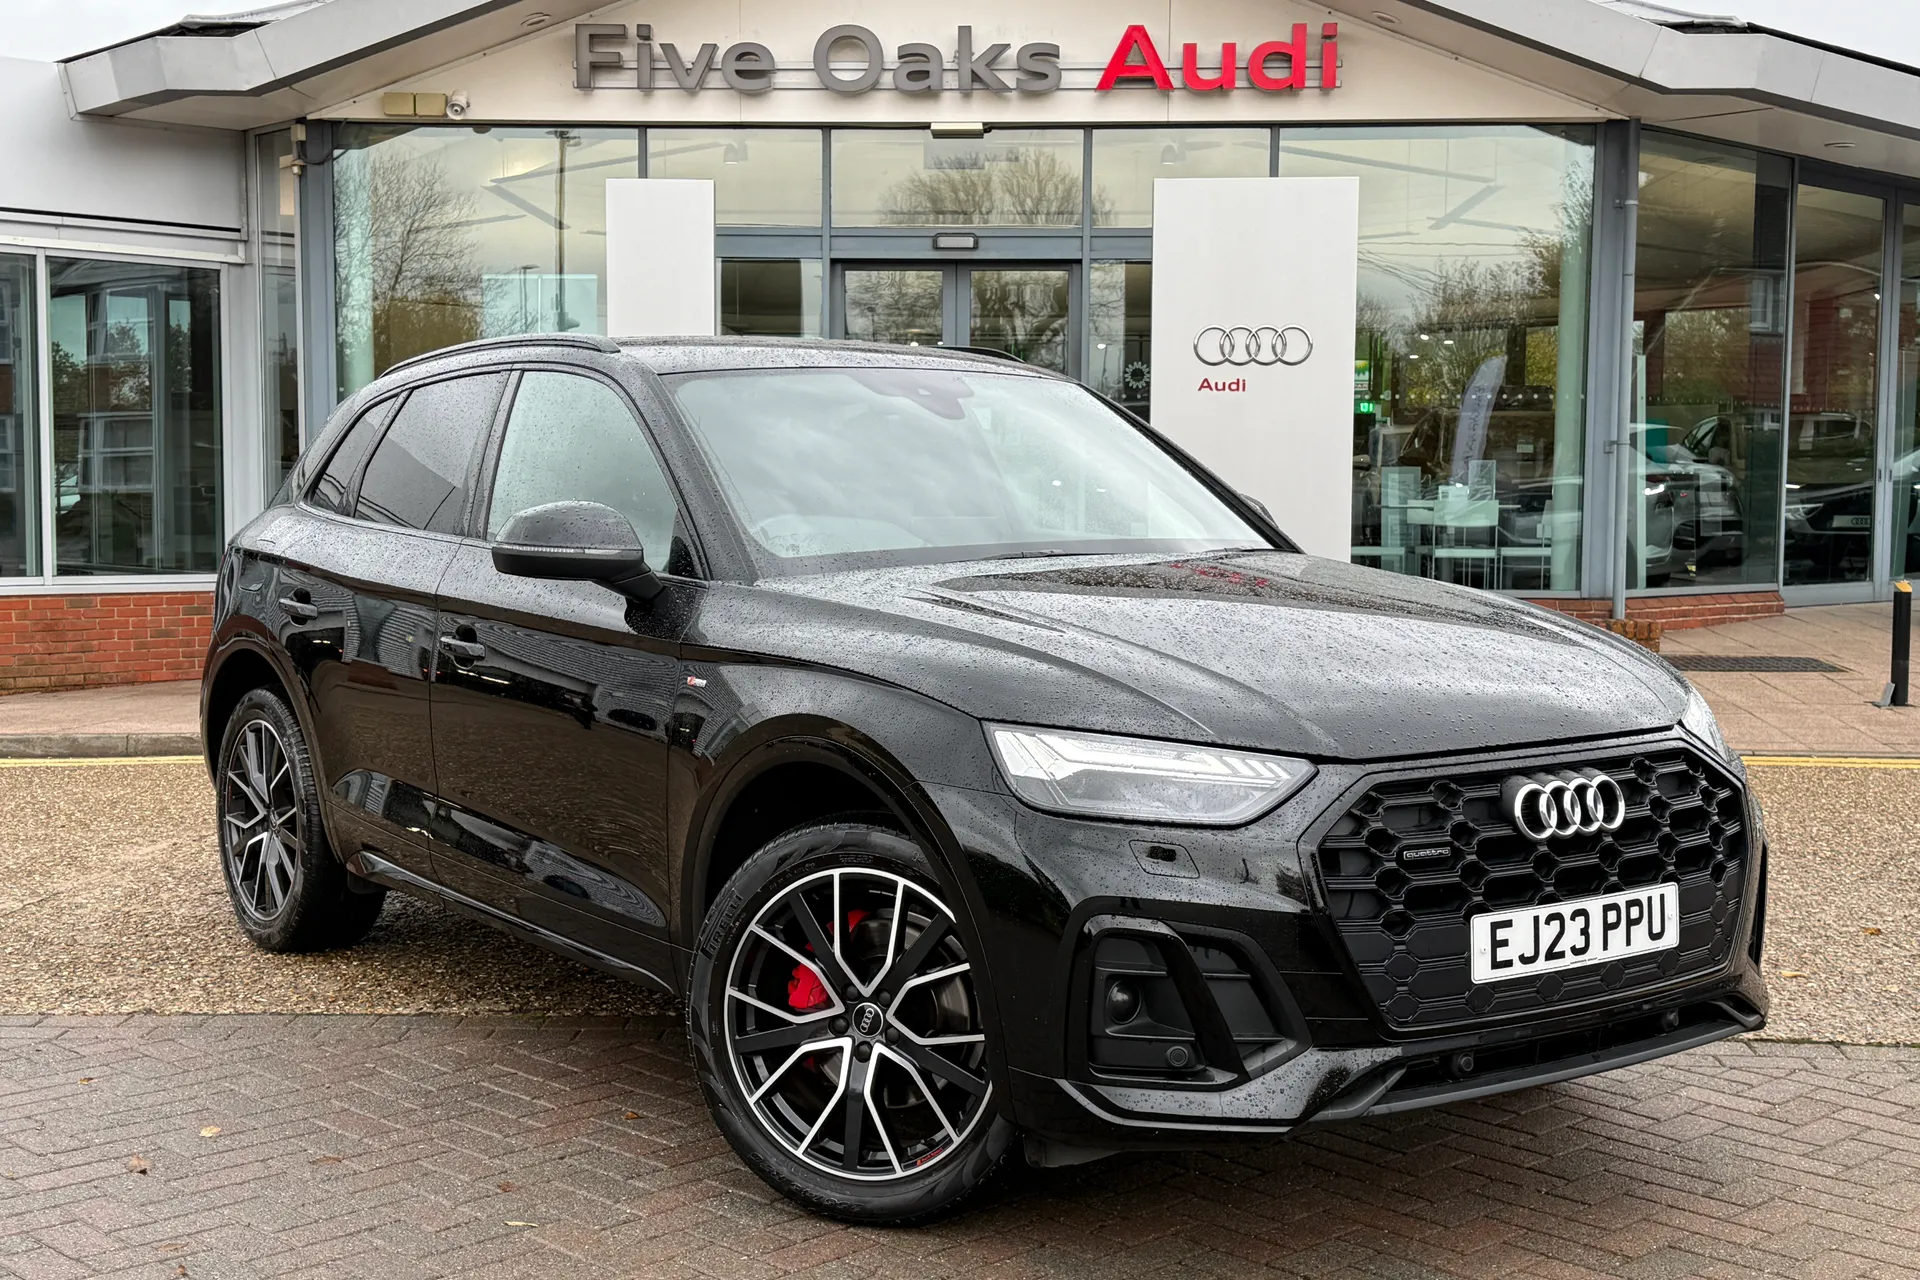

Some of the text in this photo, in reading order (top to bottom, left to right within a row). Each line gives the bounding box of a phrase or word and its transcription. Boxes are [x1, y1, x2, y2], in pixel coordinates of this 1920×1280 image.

[575, 22, 1338, 94] Five Oaks Audi
[1197, 377, 1246, 392] Audi
[1405, 848, 1450, 860] quattro
[1490, 893, 1665, 970] EJ23 PPU
